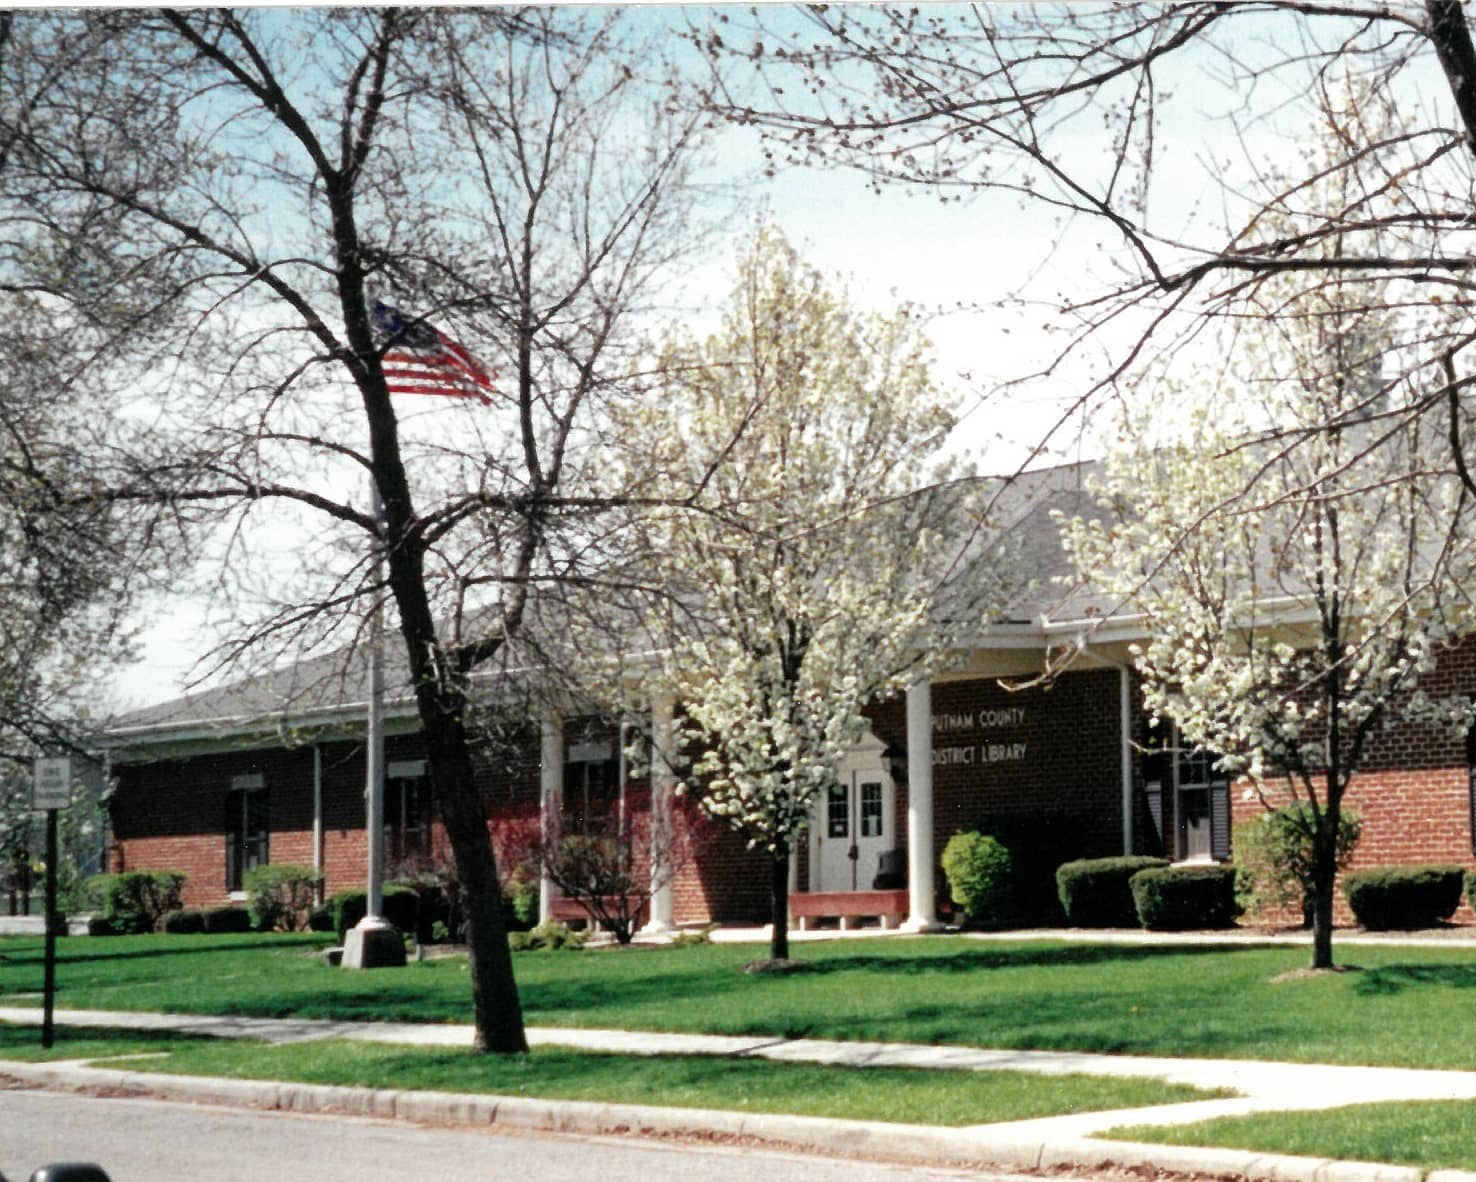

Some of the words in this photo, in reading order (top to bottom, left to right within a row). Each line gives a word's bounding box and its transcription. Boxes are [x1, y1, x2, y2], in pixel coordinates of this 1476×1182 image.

[980, 708, 1025, 727] COUNTY
[931, 747, 975, 765] DISTRICT
[981, 743, 1027, 762] LIBRARY
